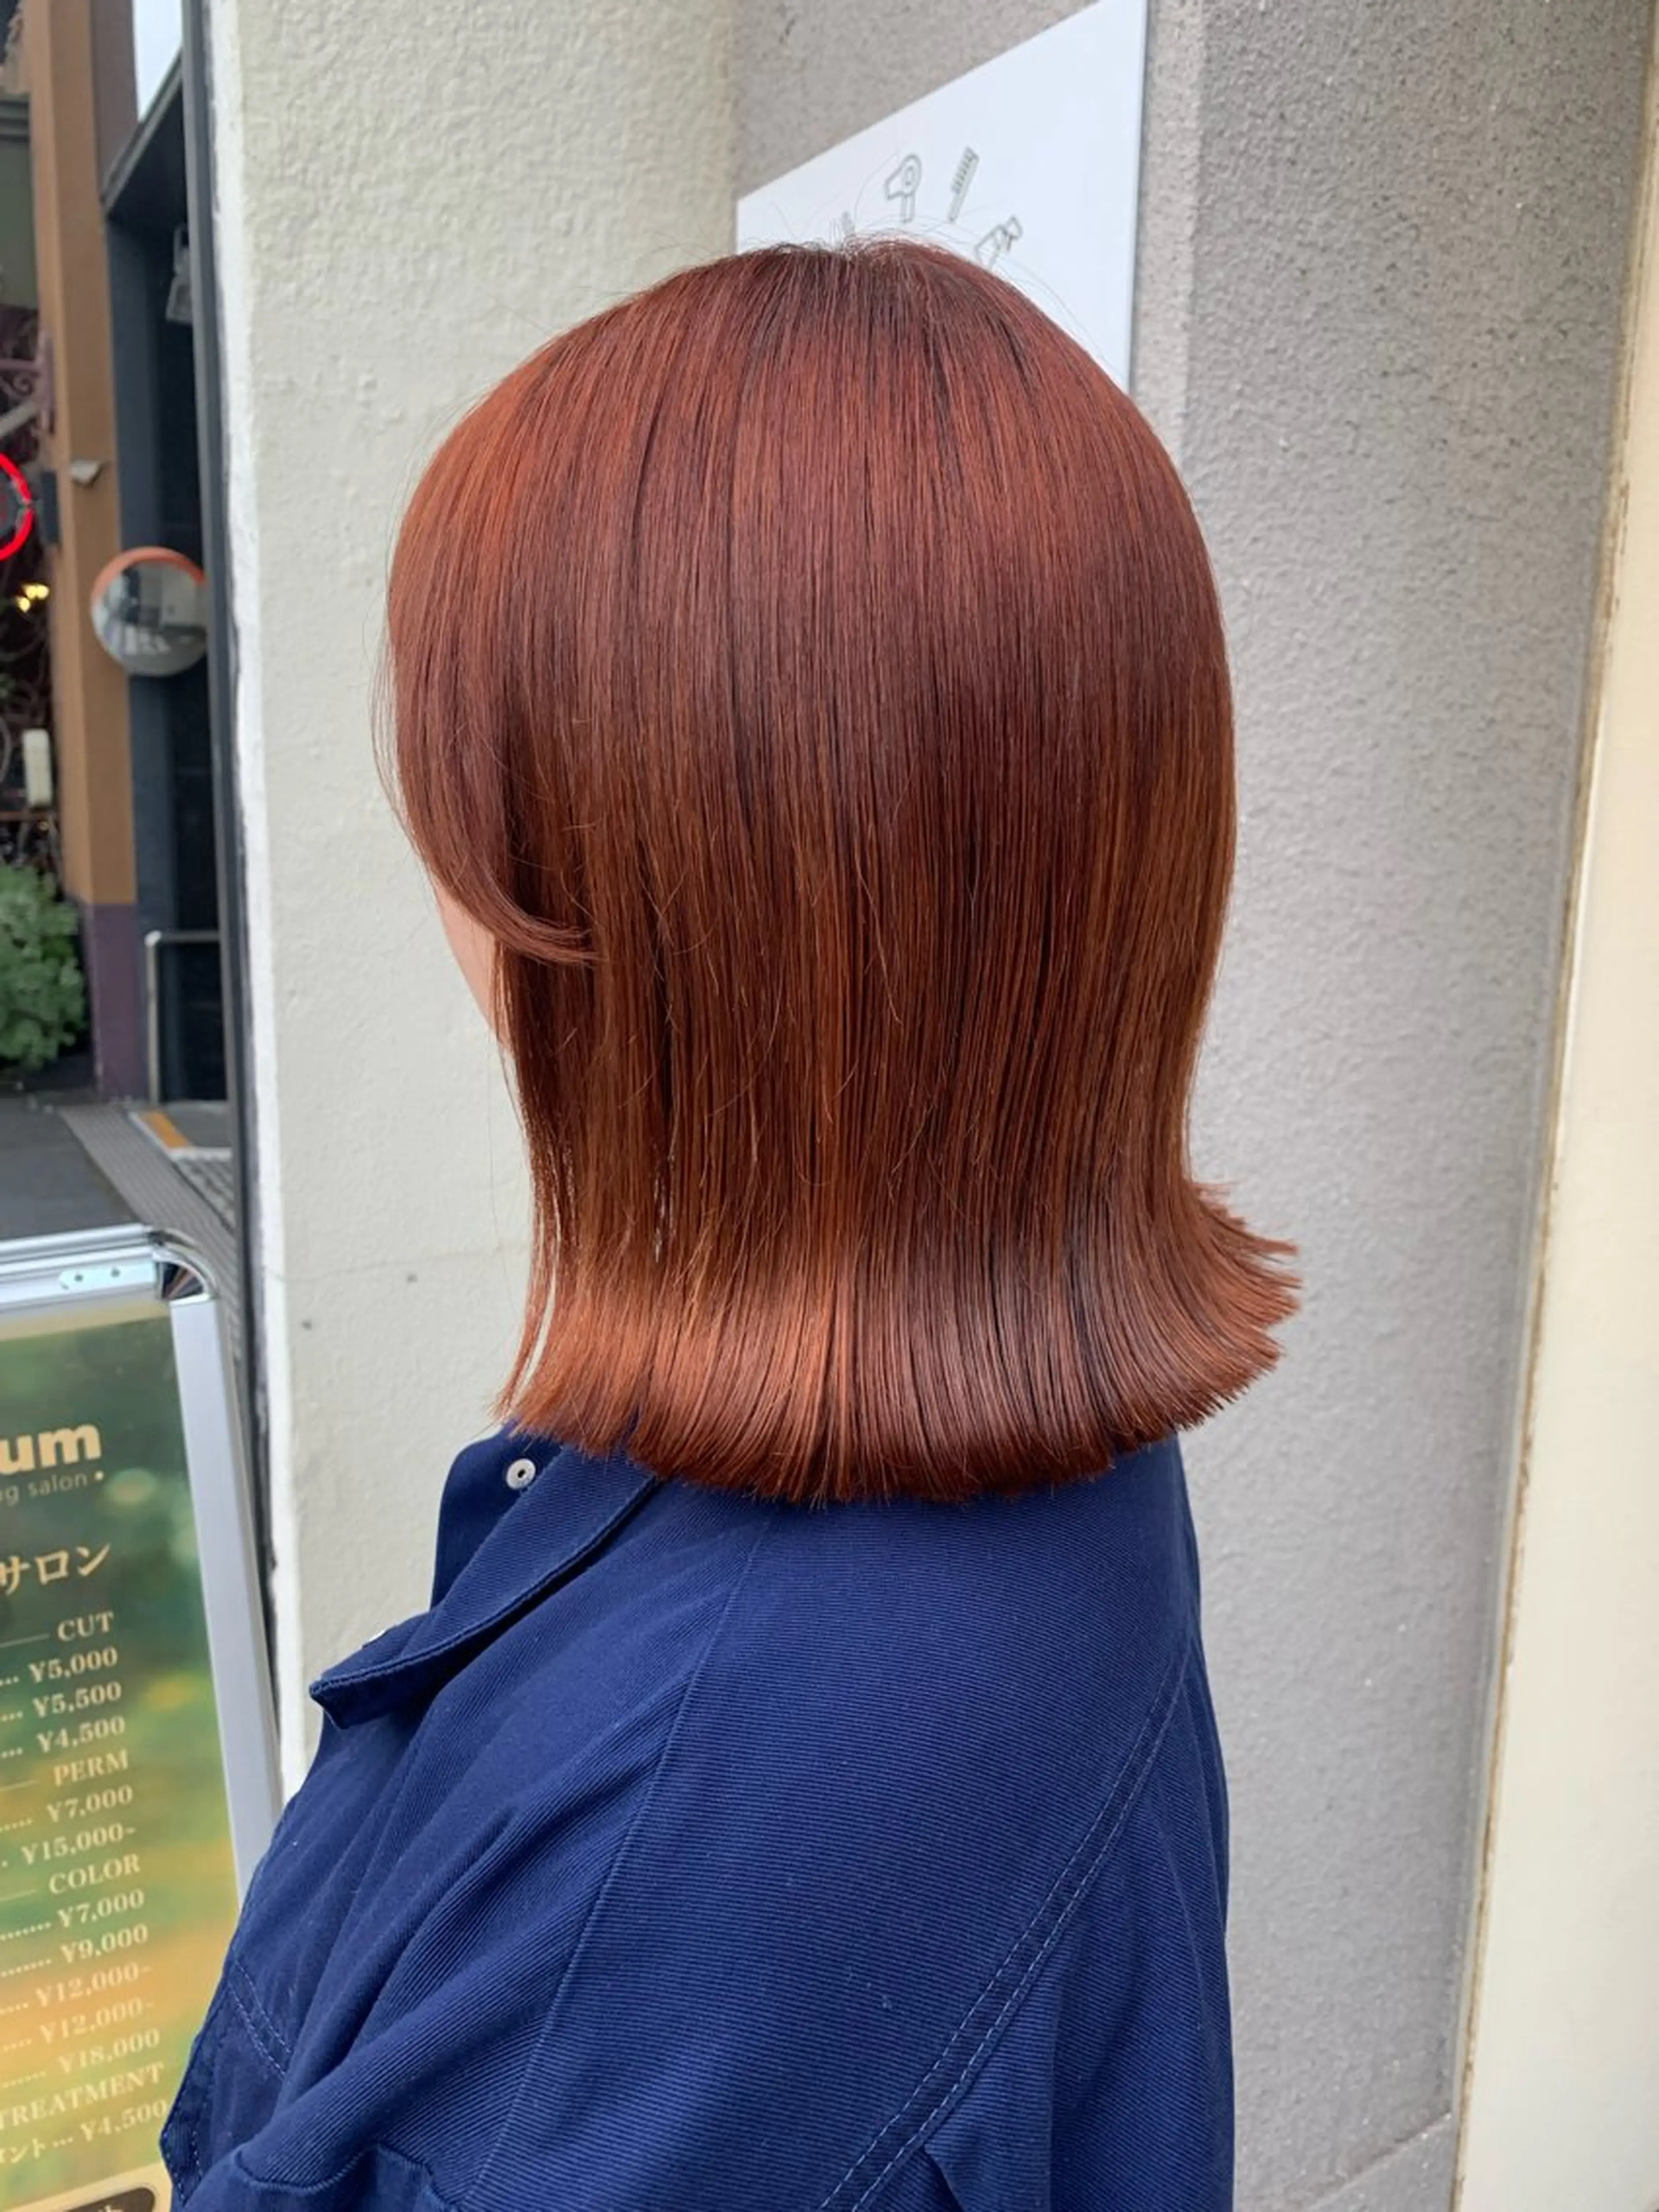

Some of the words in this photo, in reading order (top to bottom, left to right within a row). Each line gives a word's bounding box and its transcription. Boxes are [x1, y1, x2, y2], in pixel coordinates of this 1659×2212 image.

[57, 1610, 114, 1641] CUT
[29, 1646, 118, 1683] ¥5,000
[32, 1681, 122, 1718] ¥5,500
[54, 1748, 129, 1786] PERM
[47, 1785, 133, 1823] ¥7,000
[48, 1853, 141, 1894] COLOR
[57, 1888, 145, 1928] ¥7,000
